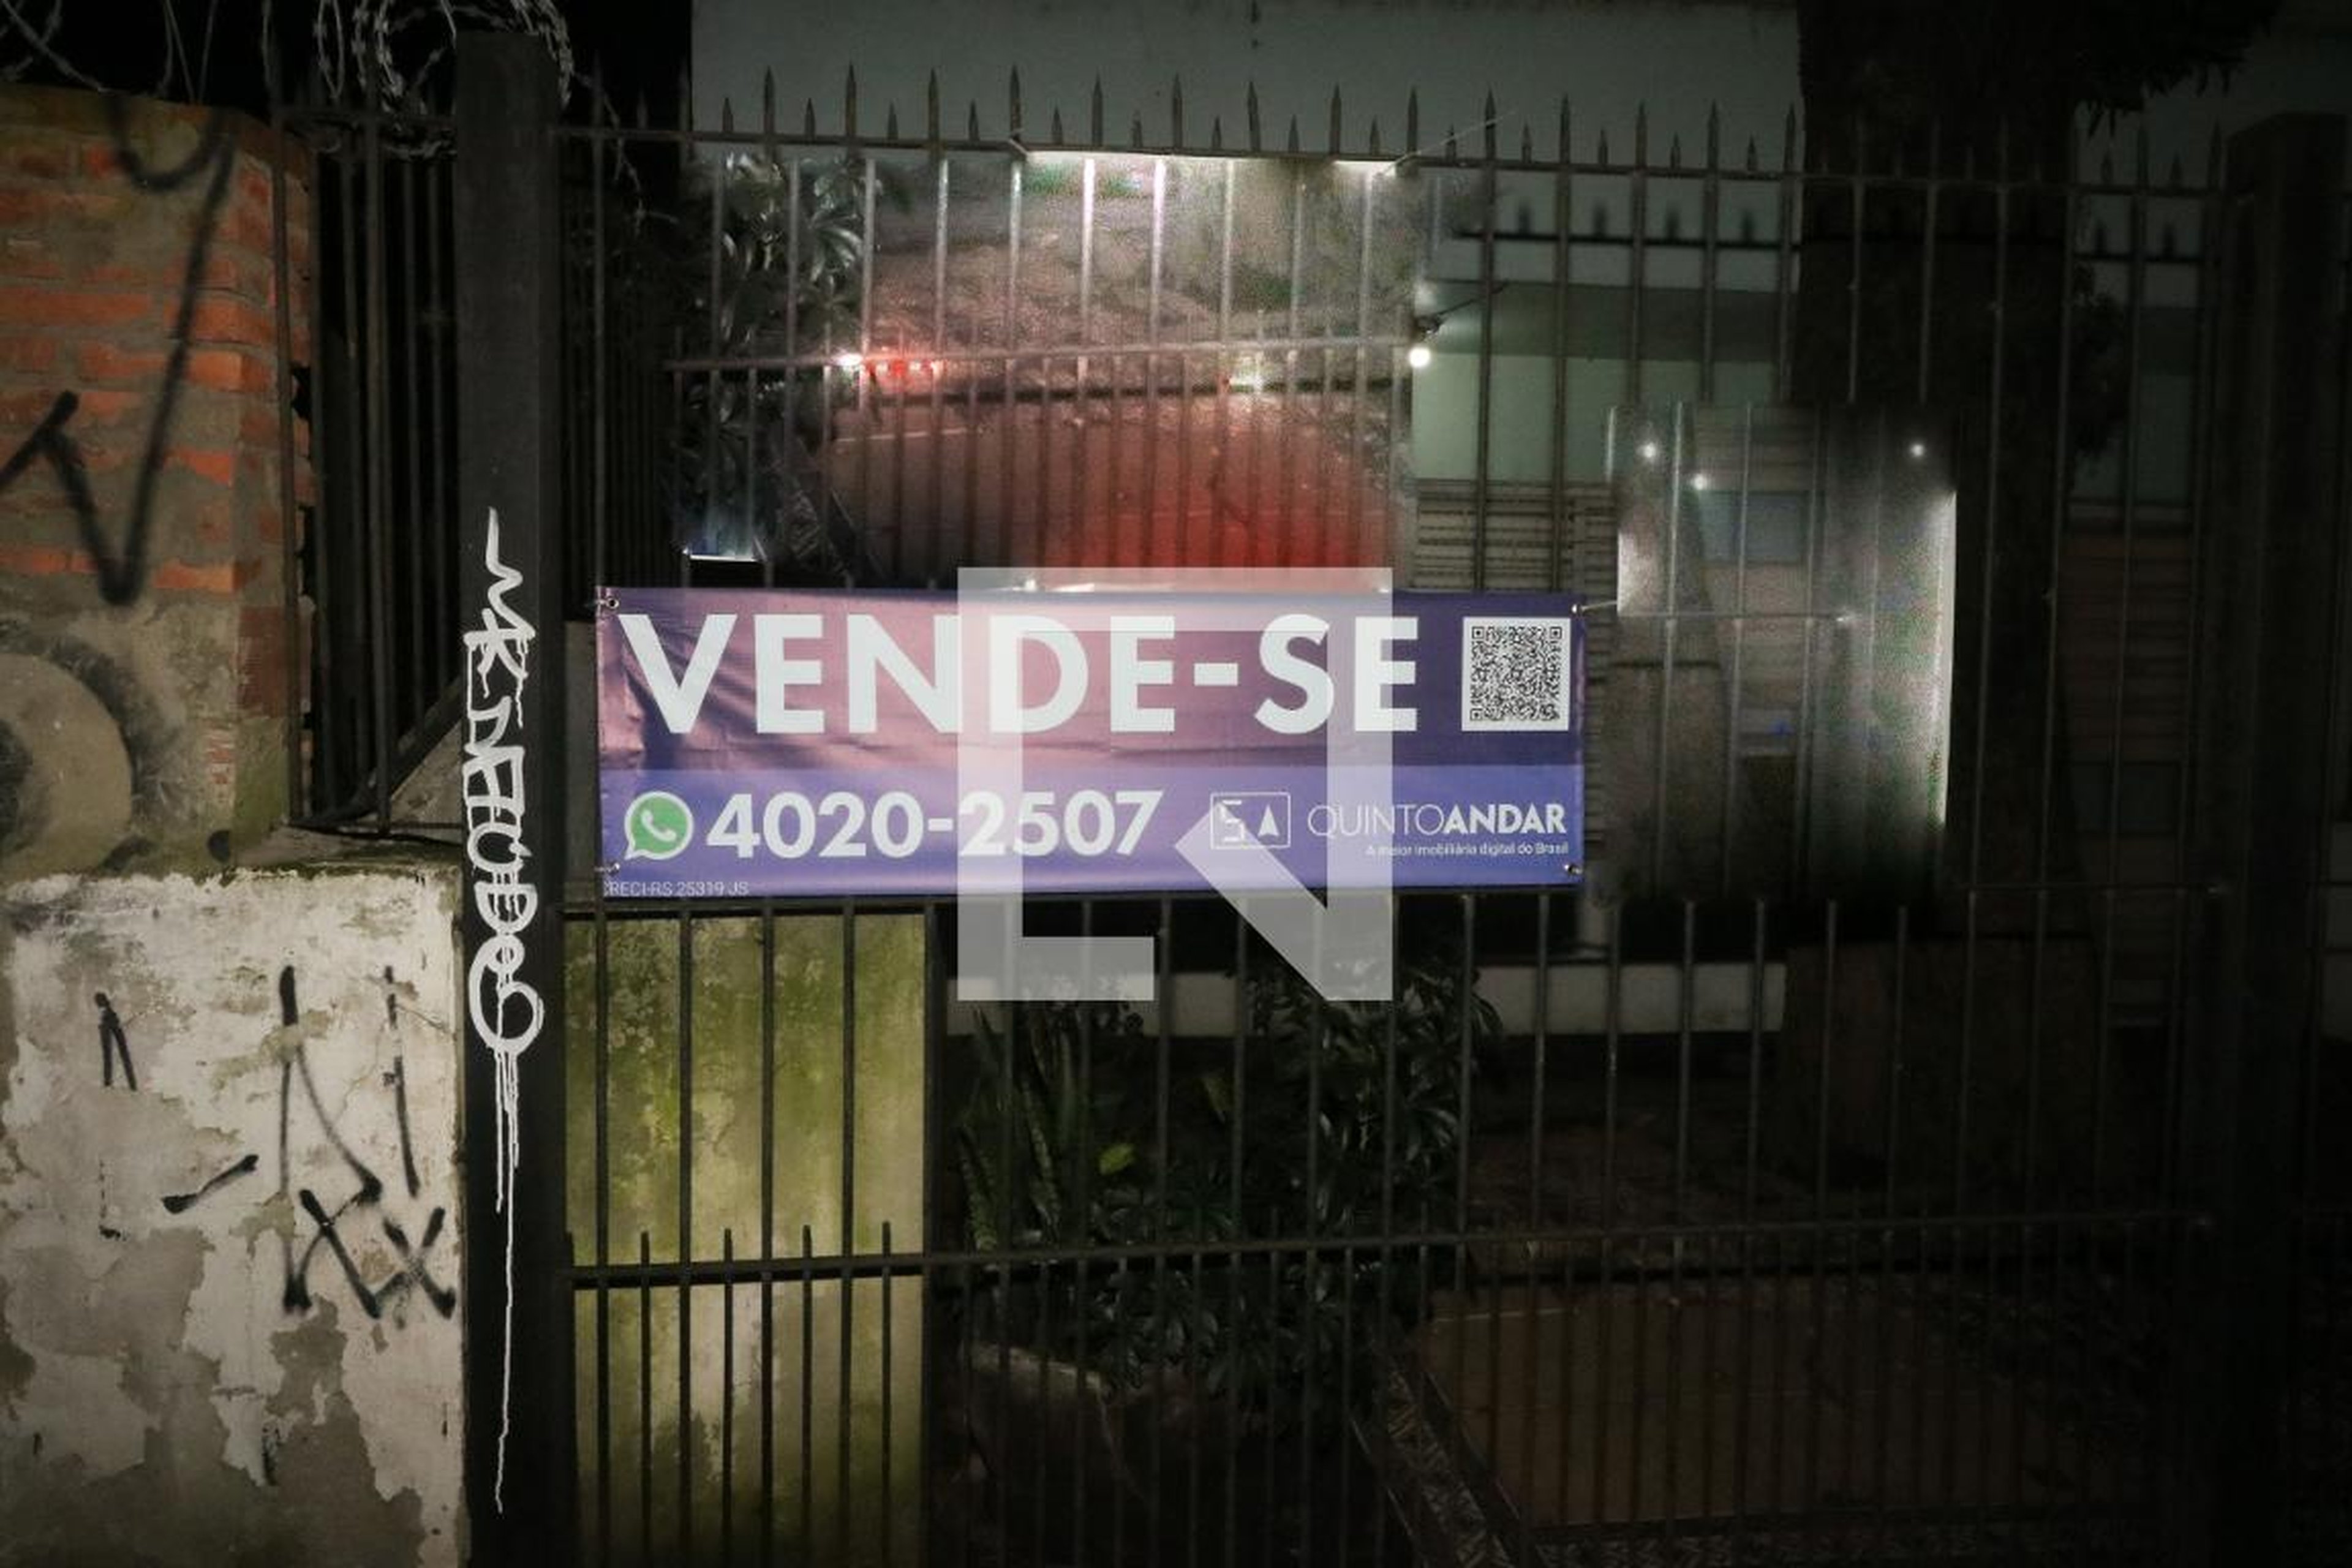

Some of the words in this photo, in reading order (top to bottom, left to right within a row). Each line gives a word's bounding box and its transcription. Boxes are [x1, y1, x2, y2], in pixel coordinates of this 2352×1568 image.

[617, 613, 1419, 734] VENDE-SE
[706, 790, 1164, 858] 4020-2507
[1308, 803, 1567, 838] QUINTOANDAR
[1479, 842, 1516, 857] digital
[1517, 842, 1534, 854] do
[1536, 841, 1569, 854] Brasil
